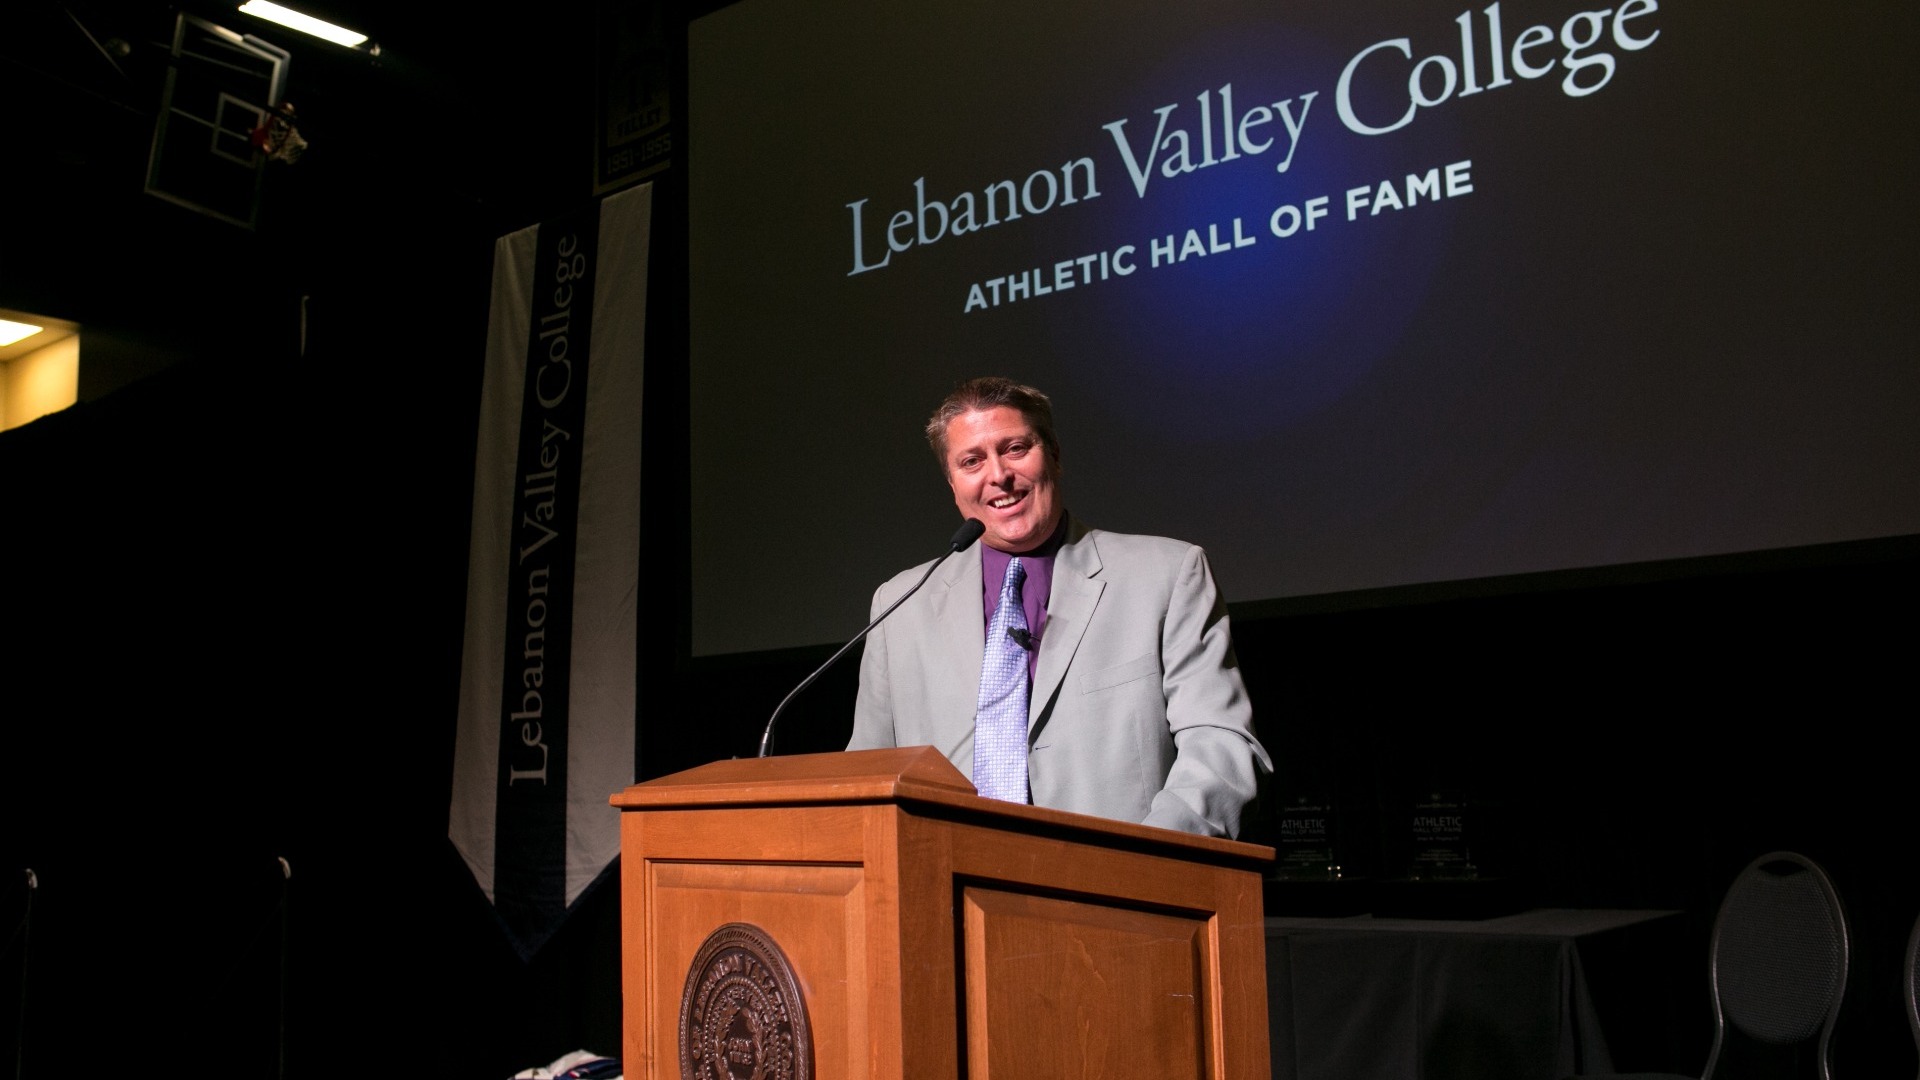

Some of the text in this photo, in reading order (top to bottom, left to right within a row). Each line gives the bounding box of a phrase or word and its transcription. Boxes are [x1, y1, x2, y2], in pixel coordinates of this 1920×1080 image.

[617, 106, 662, 138] VALLEY
[846, 0, 1660, 276] Lebanon Valley College
[606, 132, 671, 175] 1951-1955
[964, 159, 1474, 313] ATHLETIC HALL OF FAME
[509, 233, 586, 787] Lebanon Valley College
[1281, 818, 1326, 829] ATHLETIC
[1412, 816, 1463, 827] ATHLETIC
